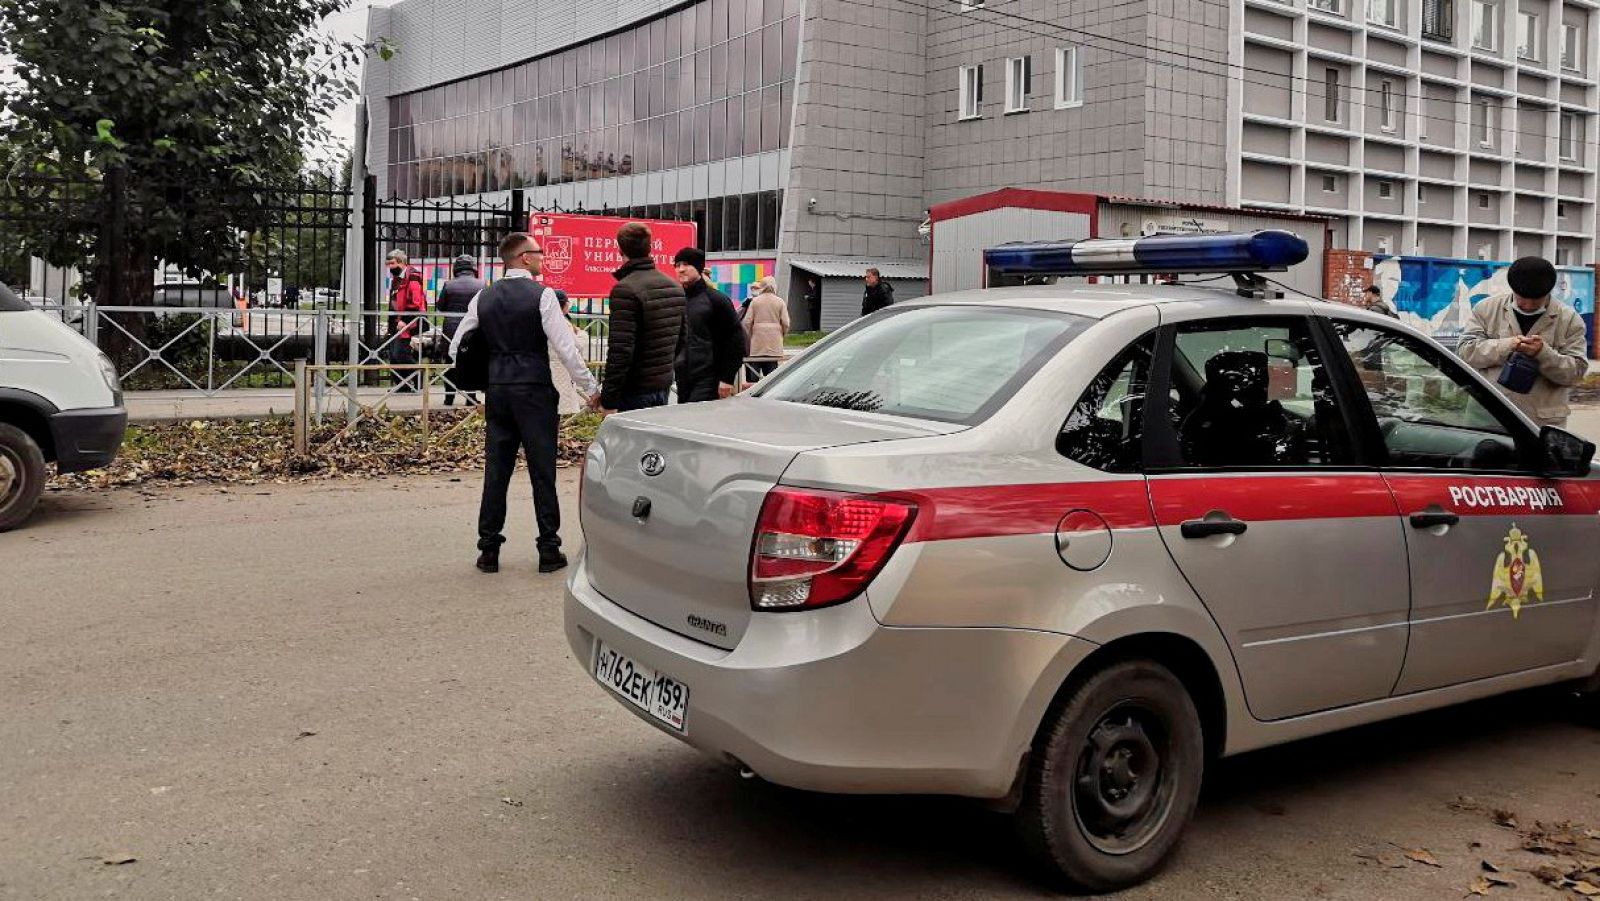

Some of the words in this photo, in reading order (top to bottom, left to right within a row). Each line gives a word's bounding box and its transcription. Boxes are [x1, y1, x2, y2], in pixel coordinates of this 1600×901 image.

[584, 237, 663, 250] ПЕРМЙ
[1448, 486, 1564, 510] РОСГВАРДИЯ
[658, 705, 671, 720] RUS
